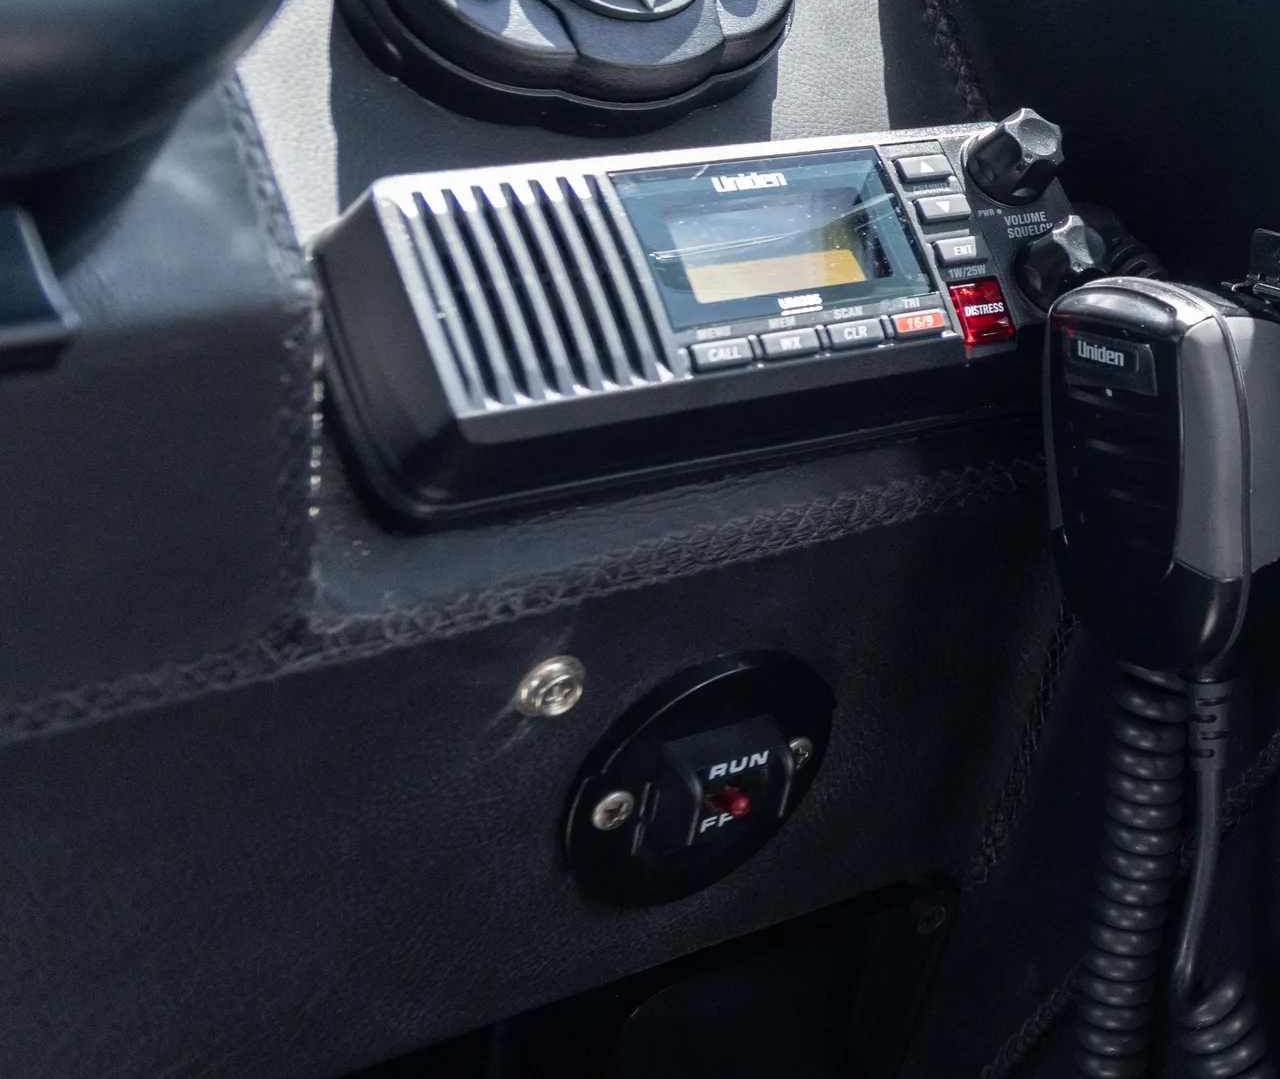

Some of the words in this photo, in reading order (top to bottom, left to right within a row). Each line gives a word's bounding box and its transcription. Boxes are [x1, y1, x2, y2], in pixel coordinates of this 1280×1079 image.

[711, 172, 787, 192] Uniden
[978, 209, 995, 217] PWR
[1004, 212, 1046, 226] VOLUME
[1007, 223, 1053, 239] SQUELCH
[953, 245, 973, 256] ENT
[949, 265, 986, 278] 1W/25W
[903, 298, 920, 309] TRI
[964, 303, 1004, 317] DISTRESS
[834, 306, 864, 320] SCAN
[906, 316, 934, 329] 16/9
[844, 326, 868, 340] CLR
[708, 347, 741, 362] CALL
[1078, 340, 1124, 367] Uniden
[709, 750, 769, 780] RUN
